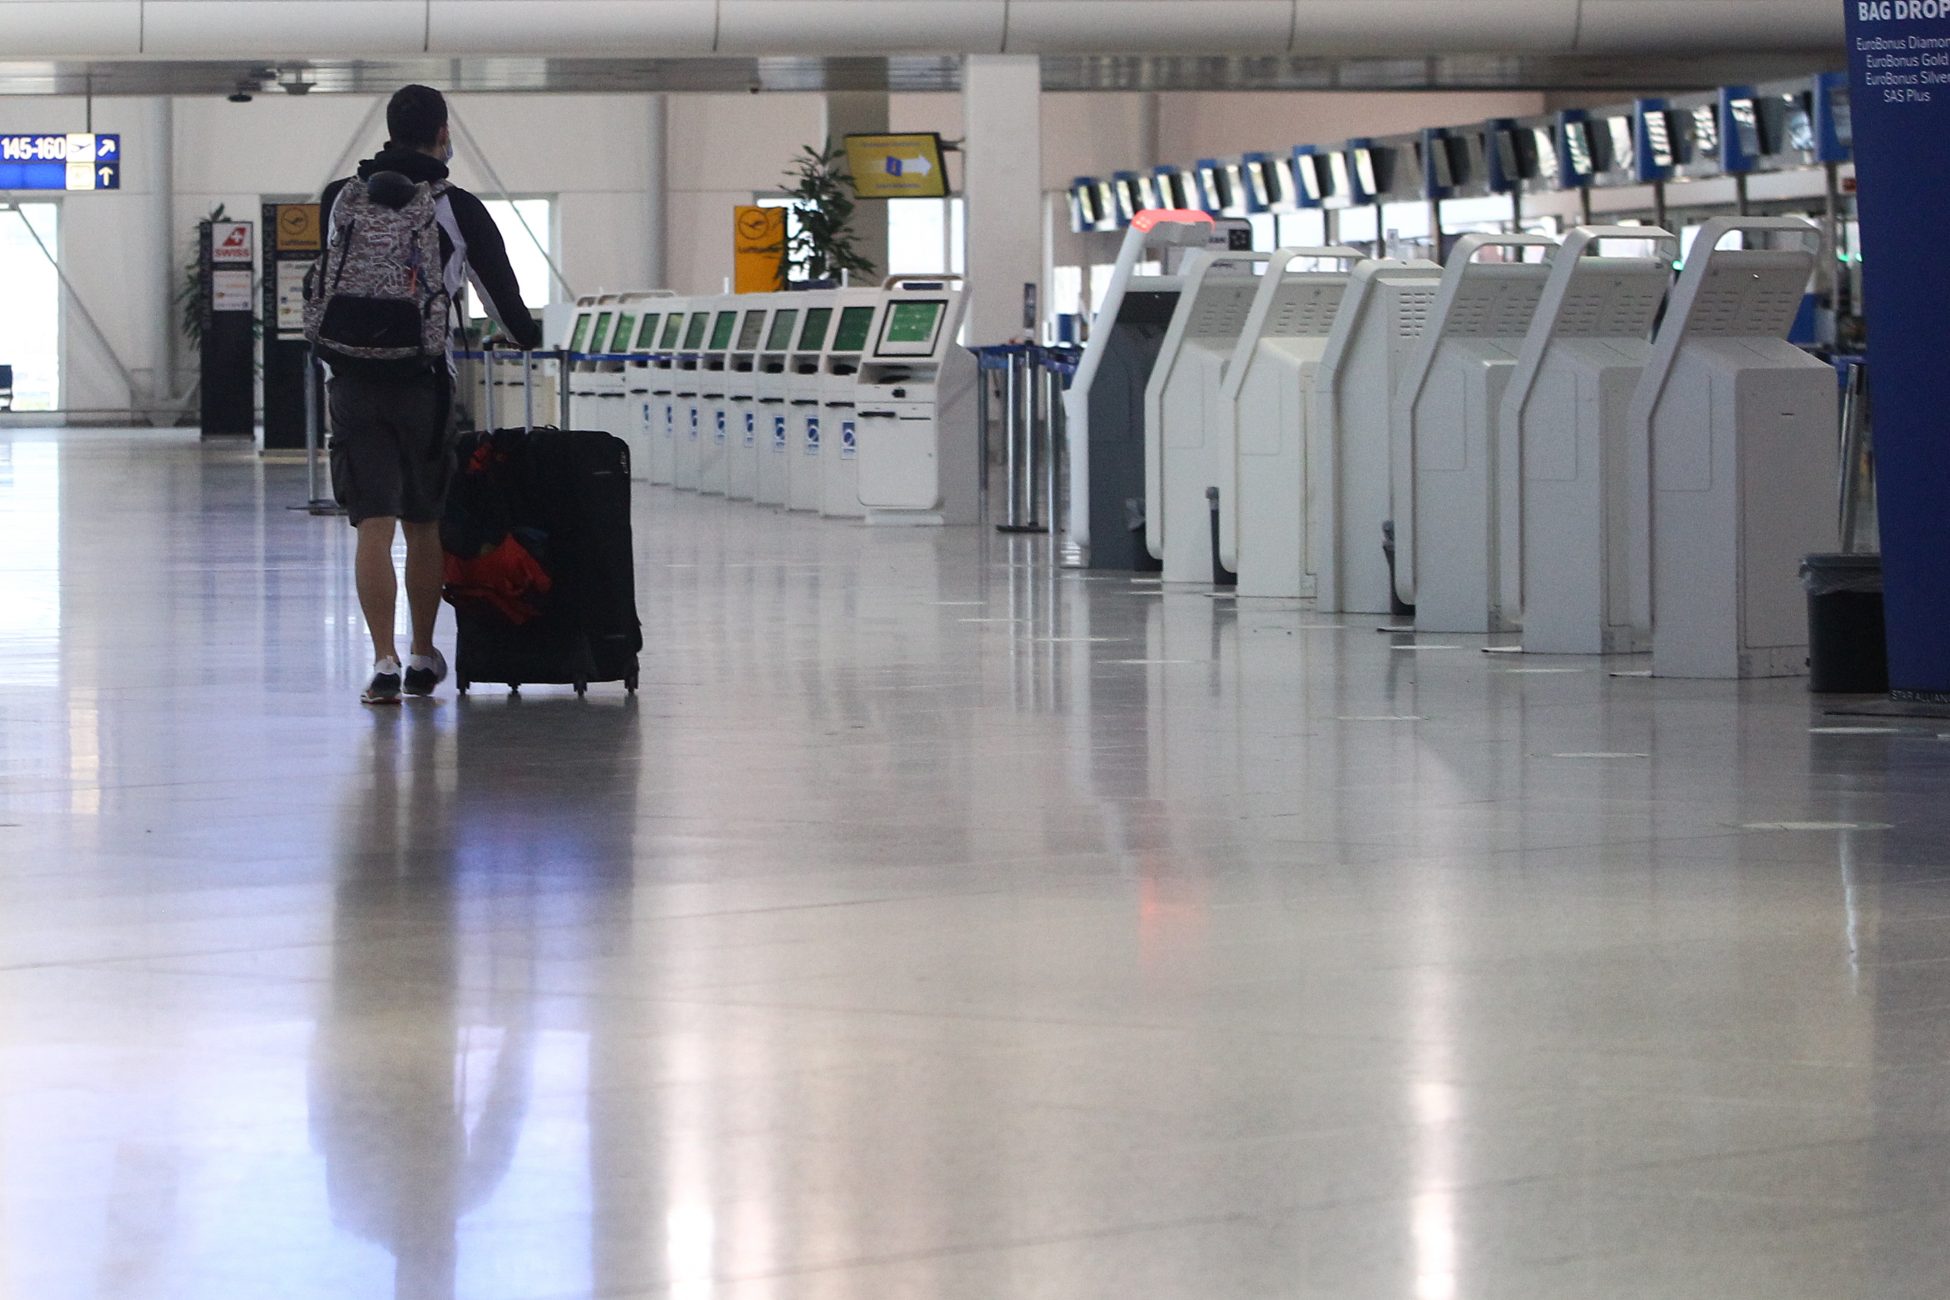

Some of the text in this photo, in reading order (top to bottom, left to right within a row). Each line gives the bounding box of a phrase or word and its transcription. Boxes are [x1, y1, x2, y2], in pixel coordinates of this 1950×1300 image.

[1858, 0, 1950, 21] BAG DROP
[1856, 37, 1906, 51] EuroBonus
[1866, 52, 1949, 68] EuroBonus Gold
[1865, 72, 1918, 86] EuroBonus
[1883, 89, 1930, 102] SAS Plus
[1, 137, 66, 159] 145-160
[215, 248, 250, 257] SWISS
